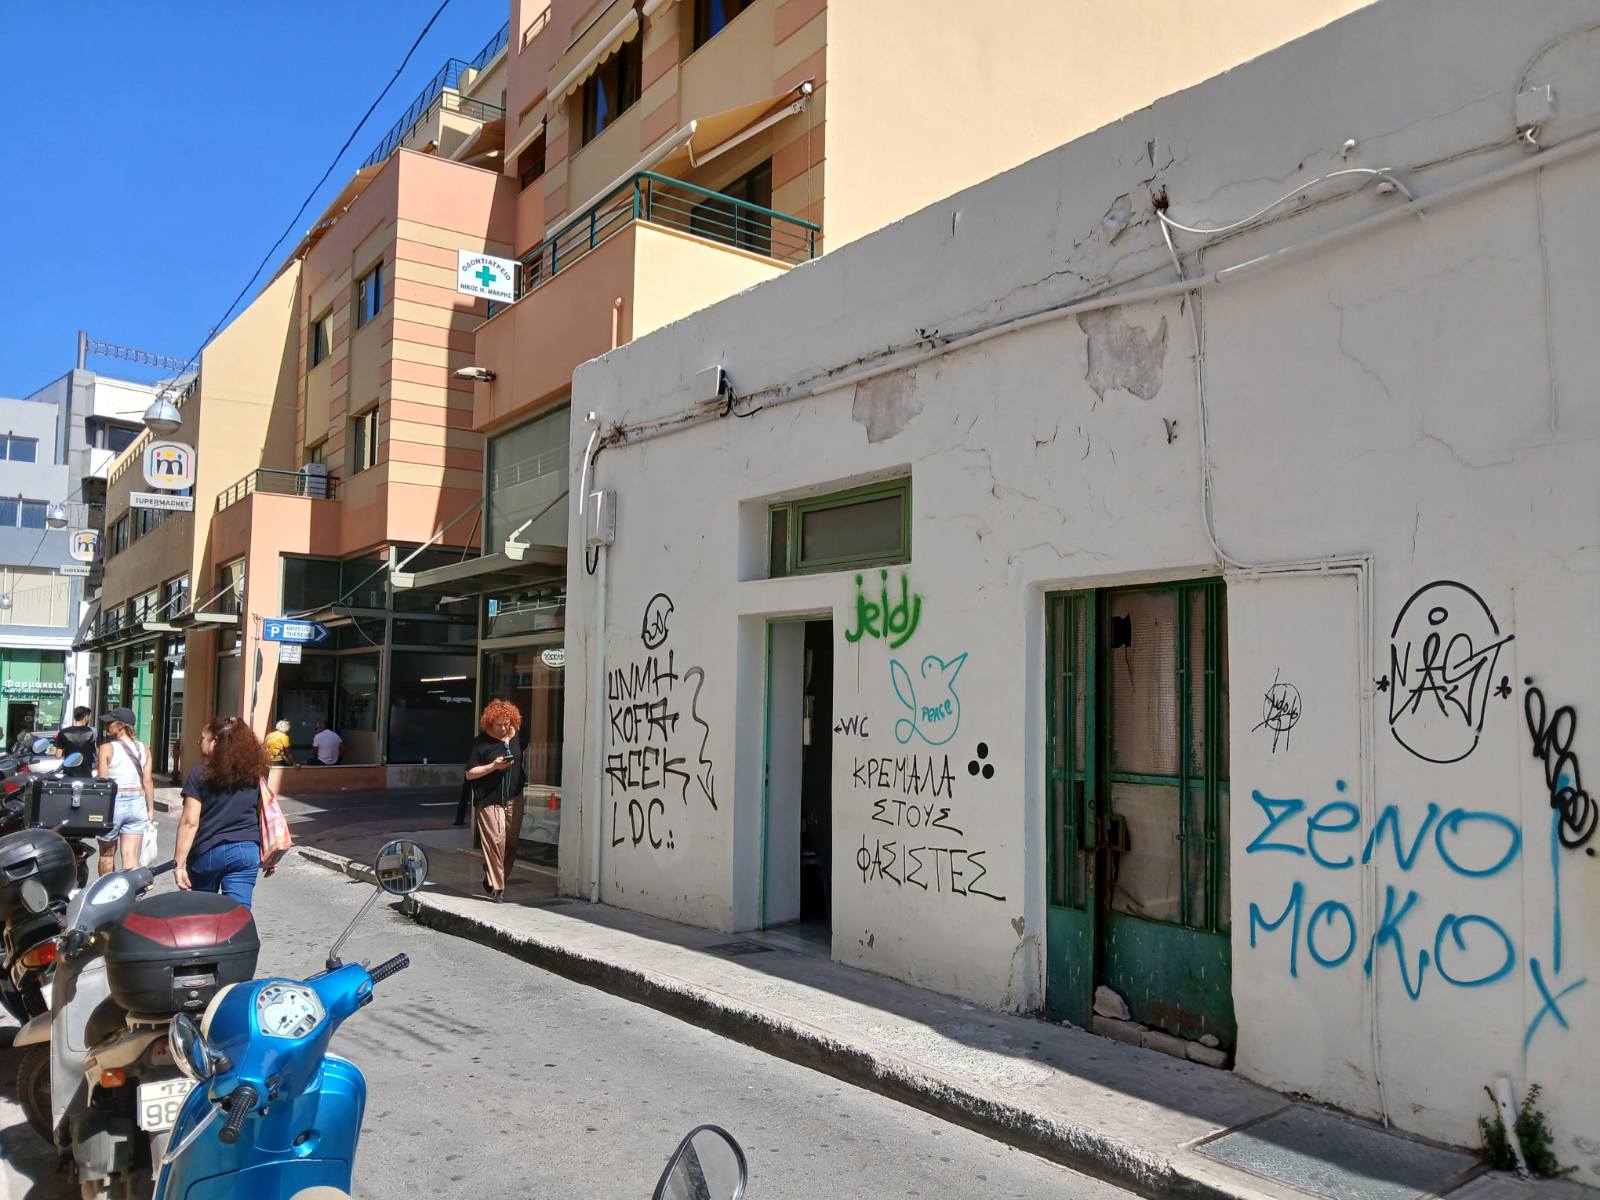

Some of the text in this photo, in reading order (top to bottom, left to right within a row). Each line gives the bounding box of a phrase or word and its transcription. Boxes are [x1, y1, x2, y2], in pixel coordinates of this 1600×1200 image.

[462, 258, 511, 281] ΟΔΟΝΤΙΑΤΡΕΙΟ
[270, 626, 280, 638] P
[853, 754, 955, 798] ΚΡΕΜΑΛΑ
[871, 798, 963, 837] ΣΤΟΥΣ
[856, 834, 1006, 902] ΦΑΣΙΣΤΕΣ
[146, 1101, 181, 1127] 98
